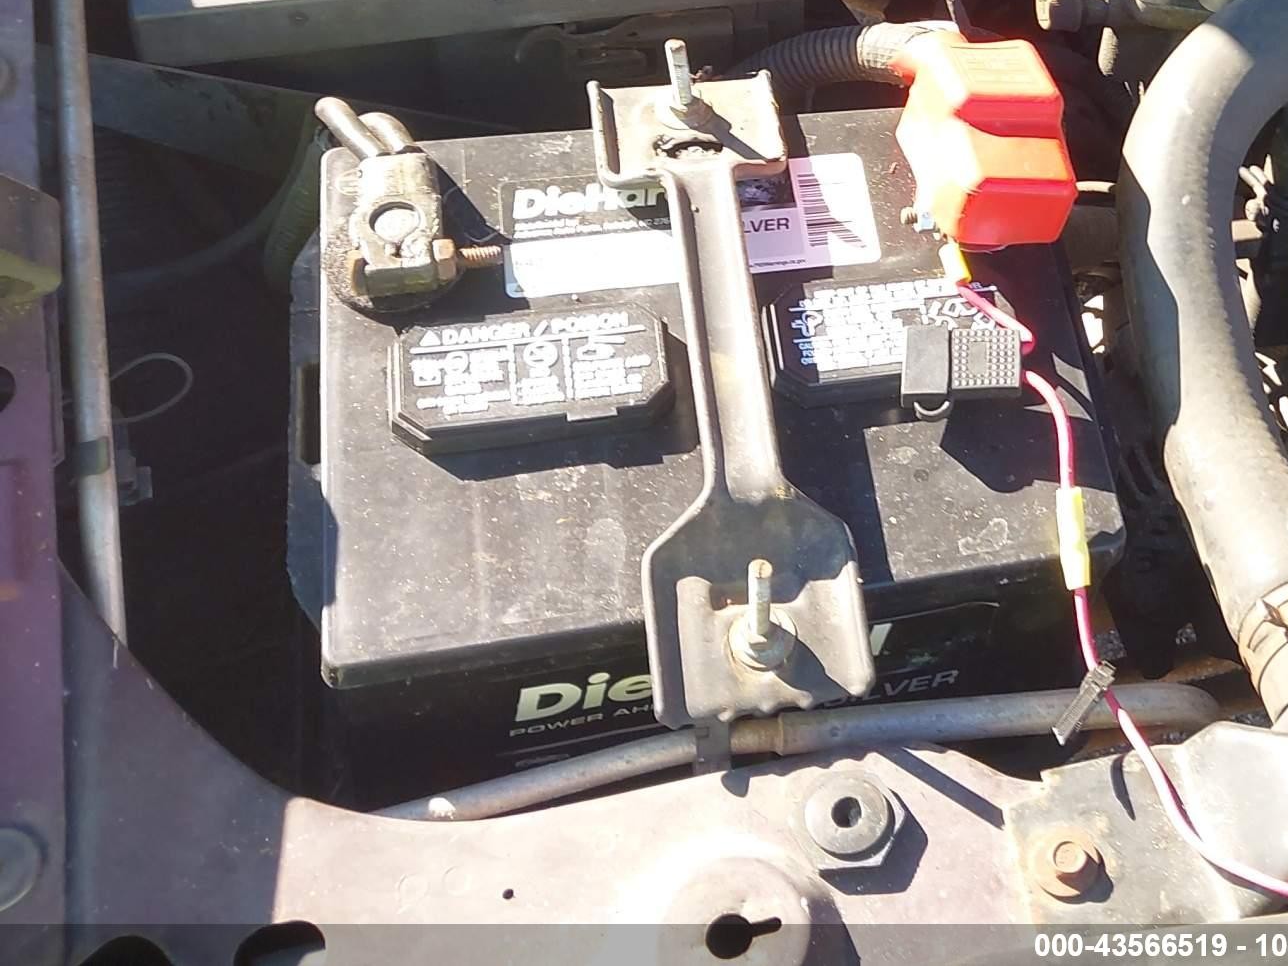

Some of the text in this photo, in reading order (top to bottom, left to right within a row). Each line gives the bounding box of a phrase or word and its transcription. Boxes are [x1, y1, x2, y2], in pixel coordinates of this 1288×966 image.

[513, 183, 669, 220] DieHar
[743, 217, 790, 233] LVER
[441, 322, 532, 344] DANGER
[550, 311, 629, 334] POISON
[514, 672, 654, 723] Die
[509, 701, 655, 737] POWER AH
